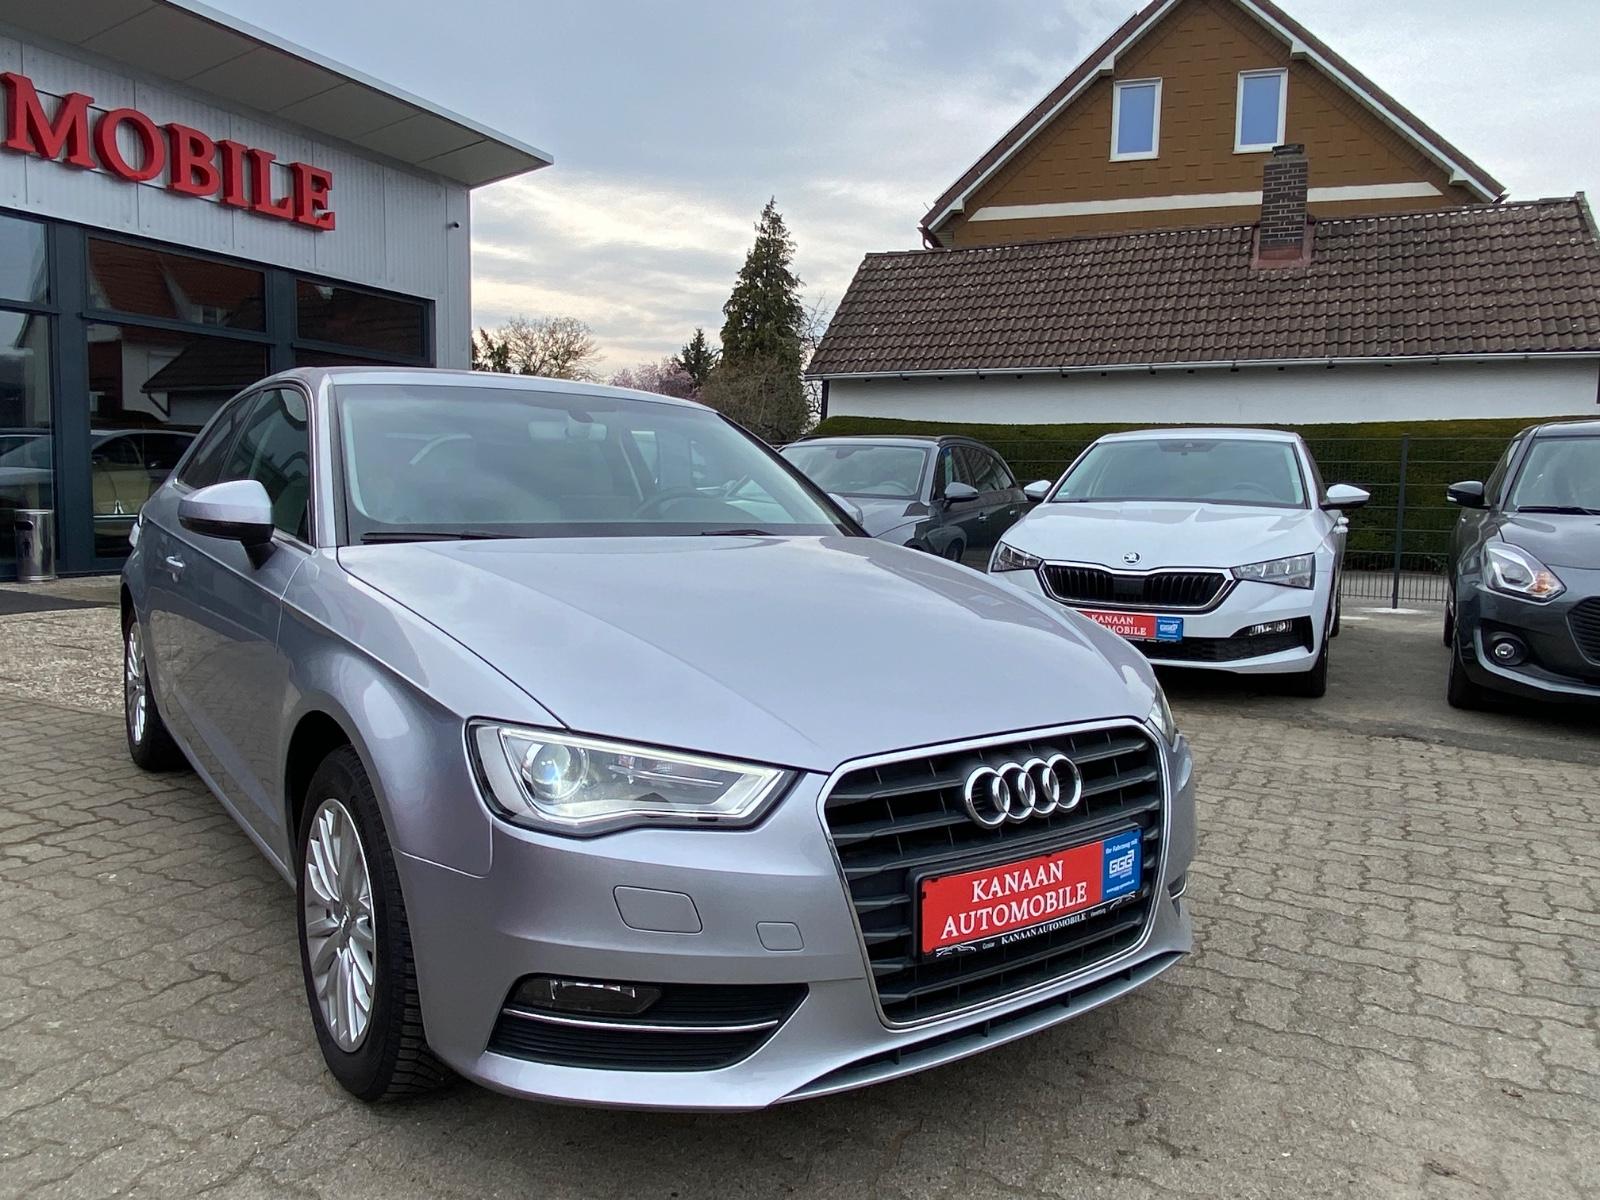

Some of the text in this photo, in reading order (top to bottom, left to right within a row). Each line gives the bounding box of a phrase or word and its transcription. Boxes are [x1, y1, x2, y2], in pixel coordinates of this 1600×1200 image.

[0, 71, 335, 231] MOBILE
[1091, 614, 1134, 625] KANAAN
[1107, 624, 1147, 636] MOBILE
[972, 860, 1064, 902] KANAAN
[940, 881, 1088, 940] AUTOMOBILE
